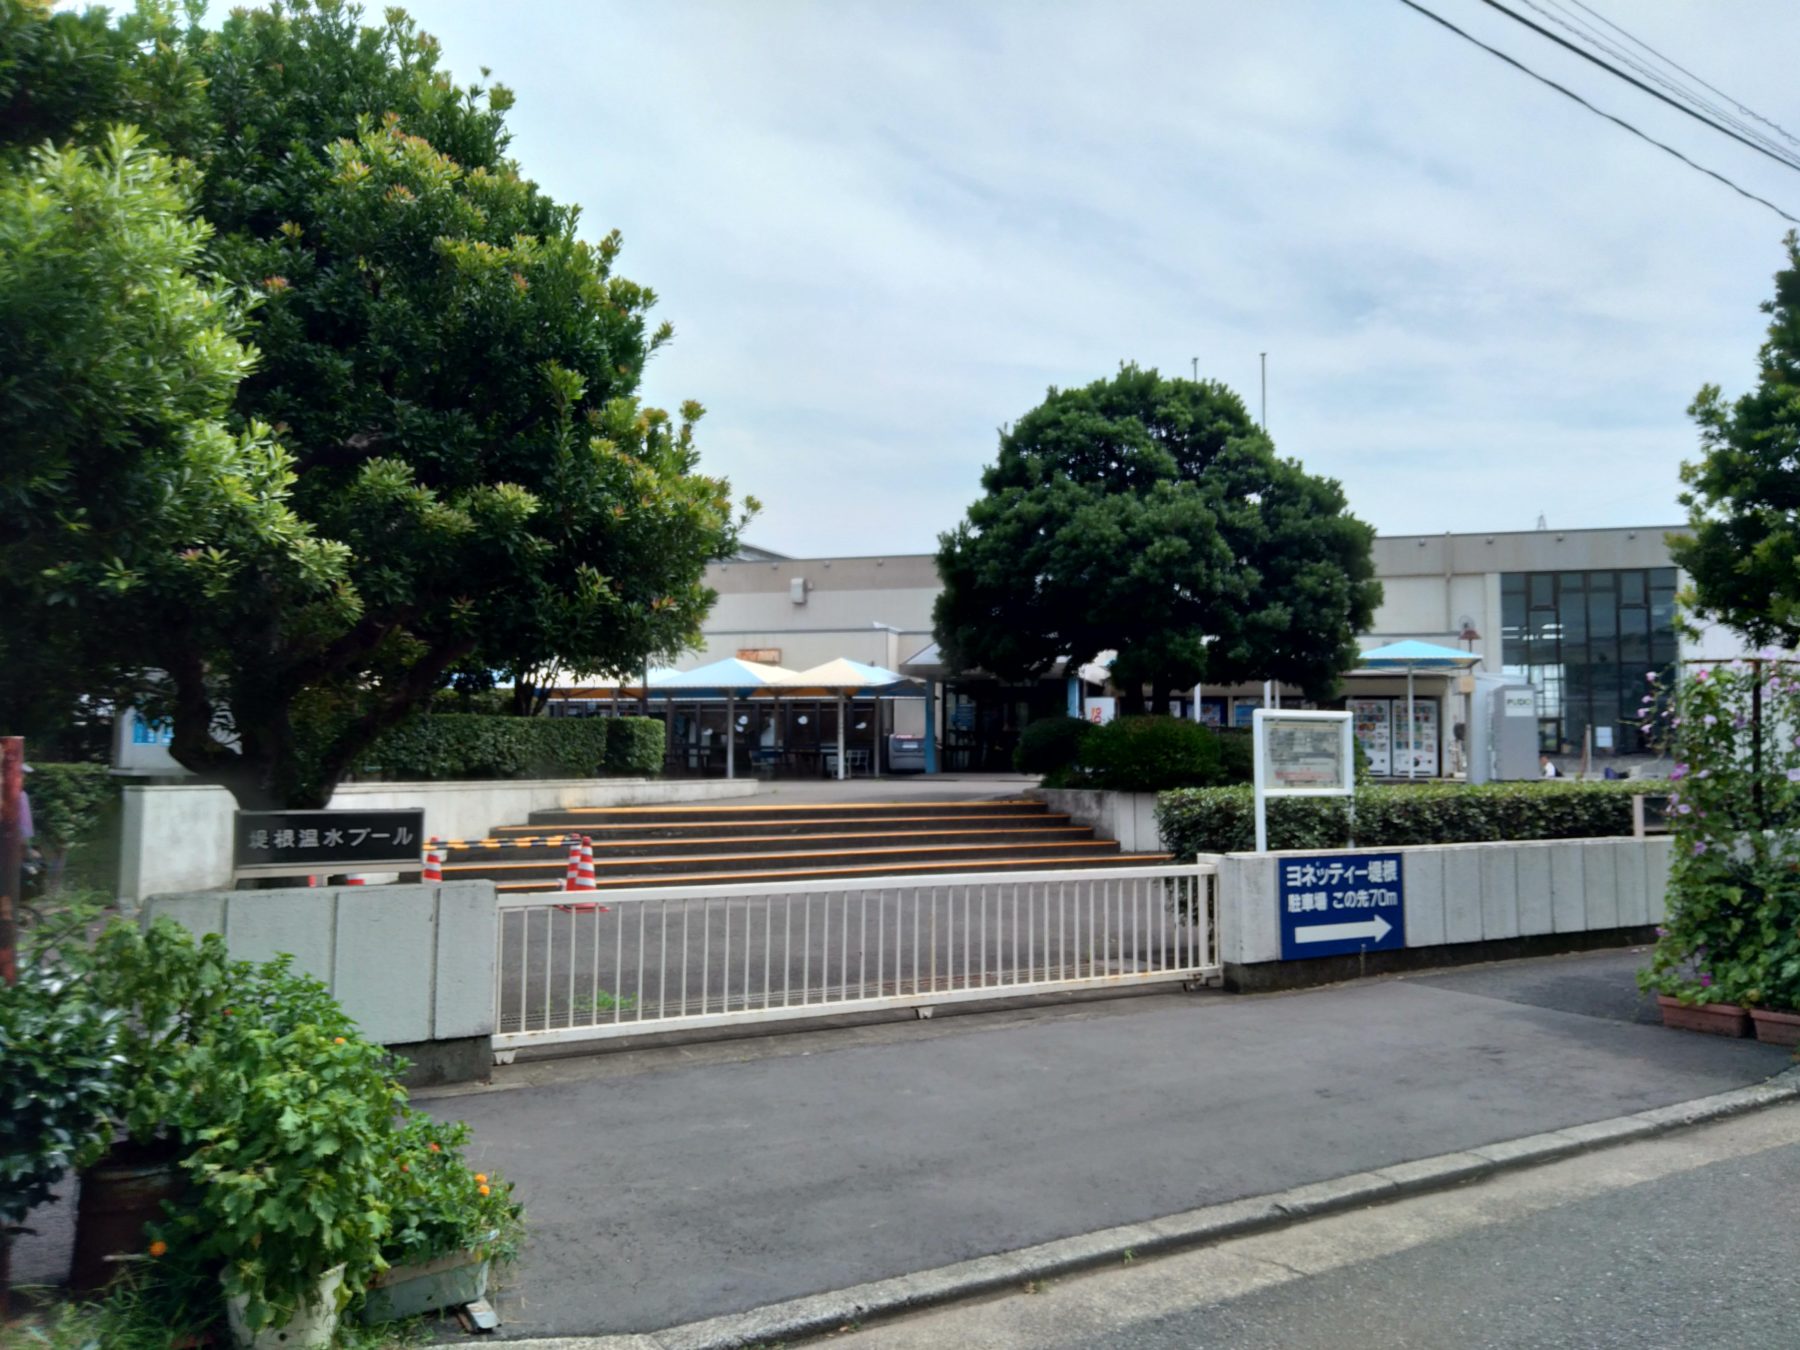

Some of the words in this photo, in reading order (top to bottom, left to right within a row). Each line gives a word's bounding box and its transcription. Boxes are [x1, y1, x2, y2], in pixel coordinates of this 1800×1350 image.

[1286, 860, 1398, 887] ヨネッティー堤根
[1288, 891, 1328, 913] 駐車場
[1332, 888, 1398, 909] この先70m
